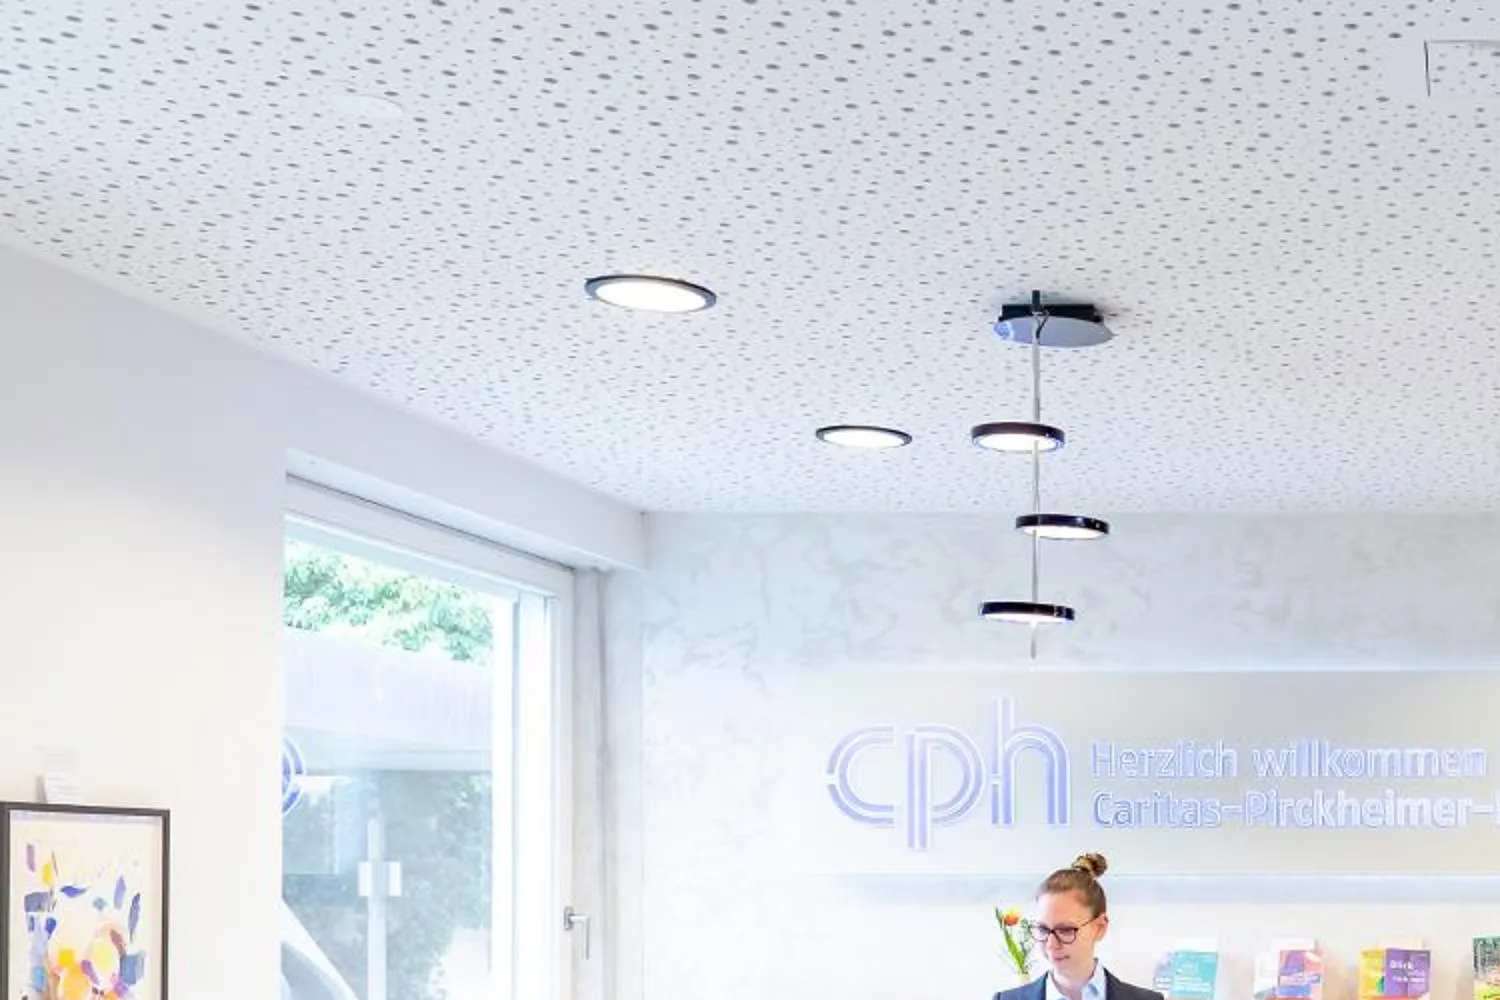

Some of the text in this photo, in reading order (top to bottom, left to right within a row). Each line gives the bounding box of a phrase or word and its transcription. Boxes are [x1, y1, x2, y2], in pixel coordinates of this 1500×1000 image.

[827, 697, 1068, 850] cph
[1091, 739, 1238, 779] Herzlich
[1252, 738, 1487, 779] willkommen
